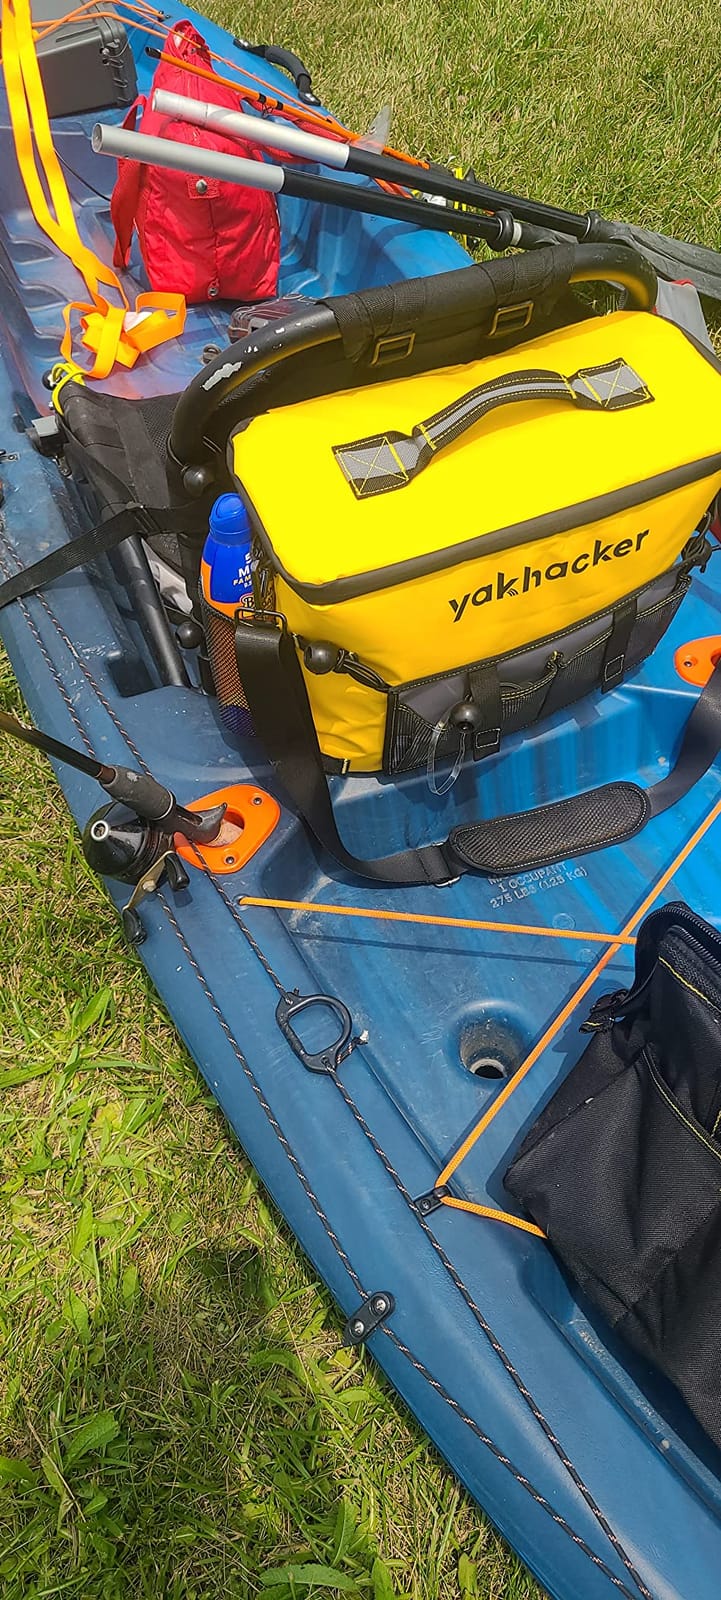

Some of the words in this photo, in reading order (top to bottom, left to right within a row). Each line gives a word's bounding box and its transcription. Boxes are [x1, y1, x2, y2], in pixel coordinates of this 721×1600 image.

[233, 574, 251, 586] FAM
[448, 529, 650, 623] yakhacker
[489, 892, 513, 909] 275
[513, 884, 537, 900] LBS
[539, 874, 566, 890] (125
[566, 866, 589, 881] KG)
[508, 861, 567, 889] OCCUPANT
